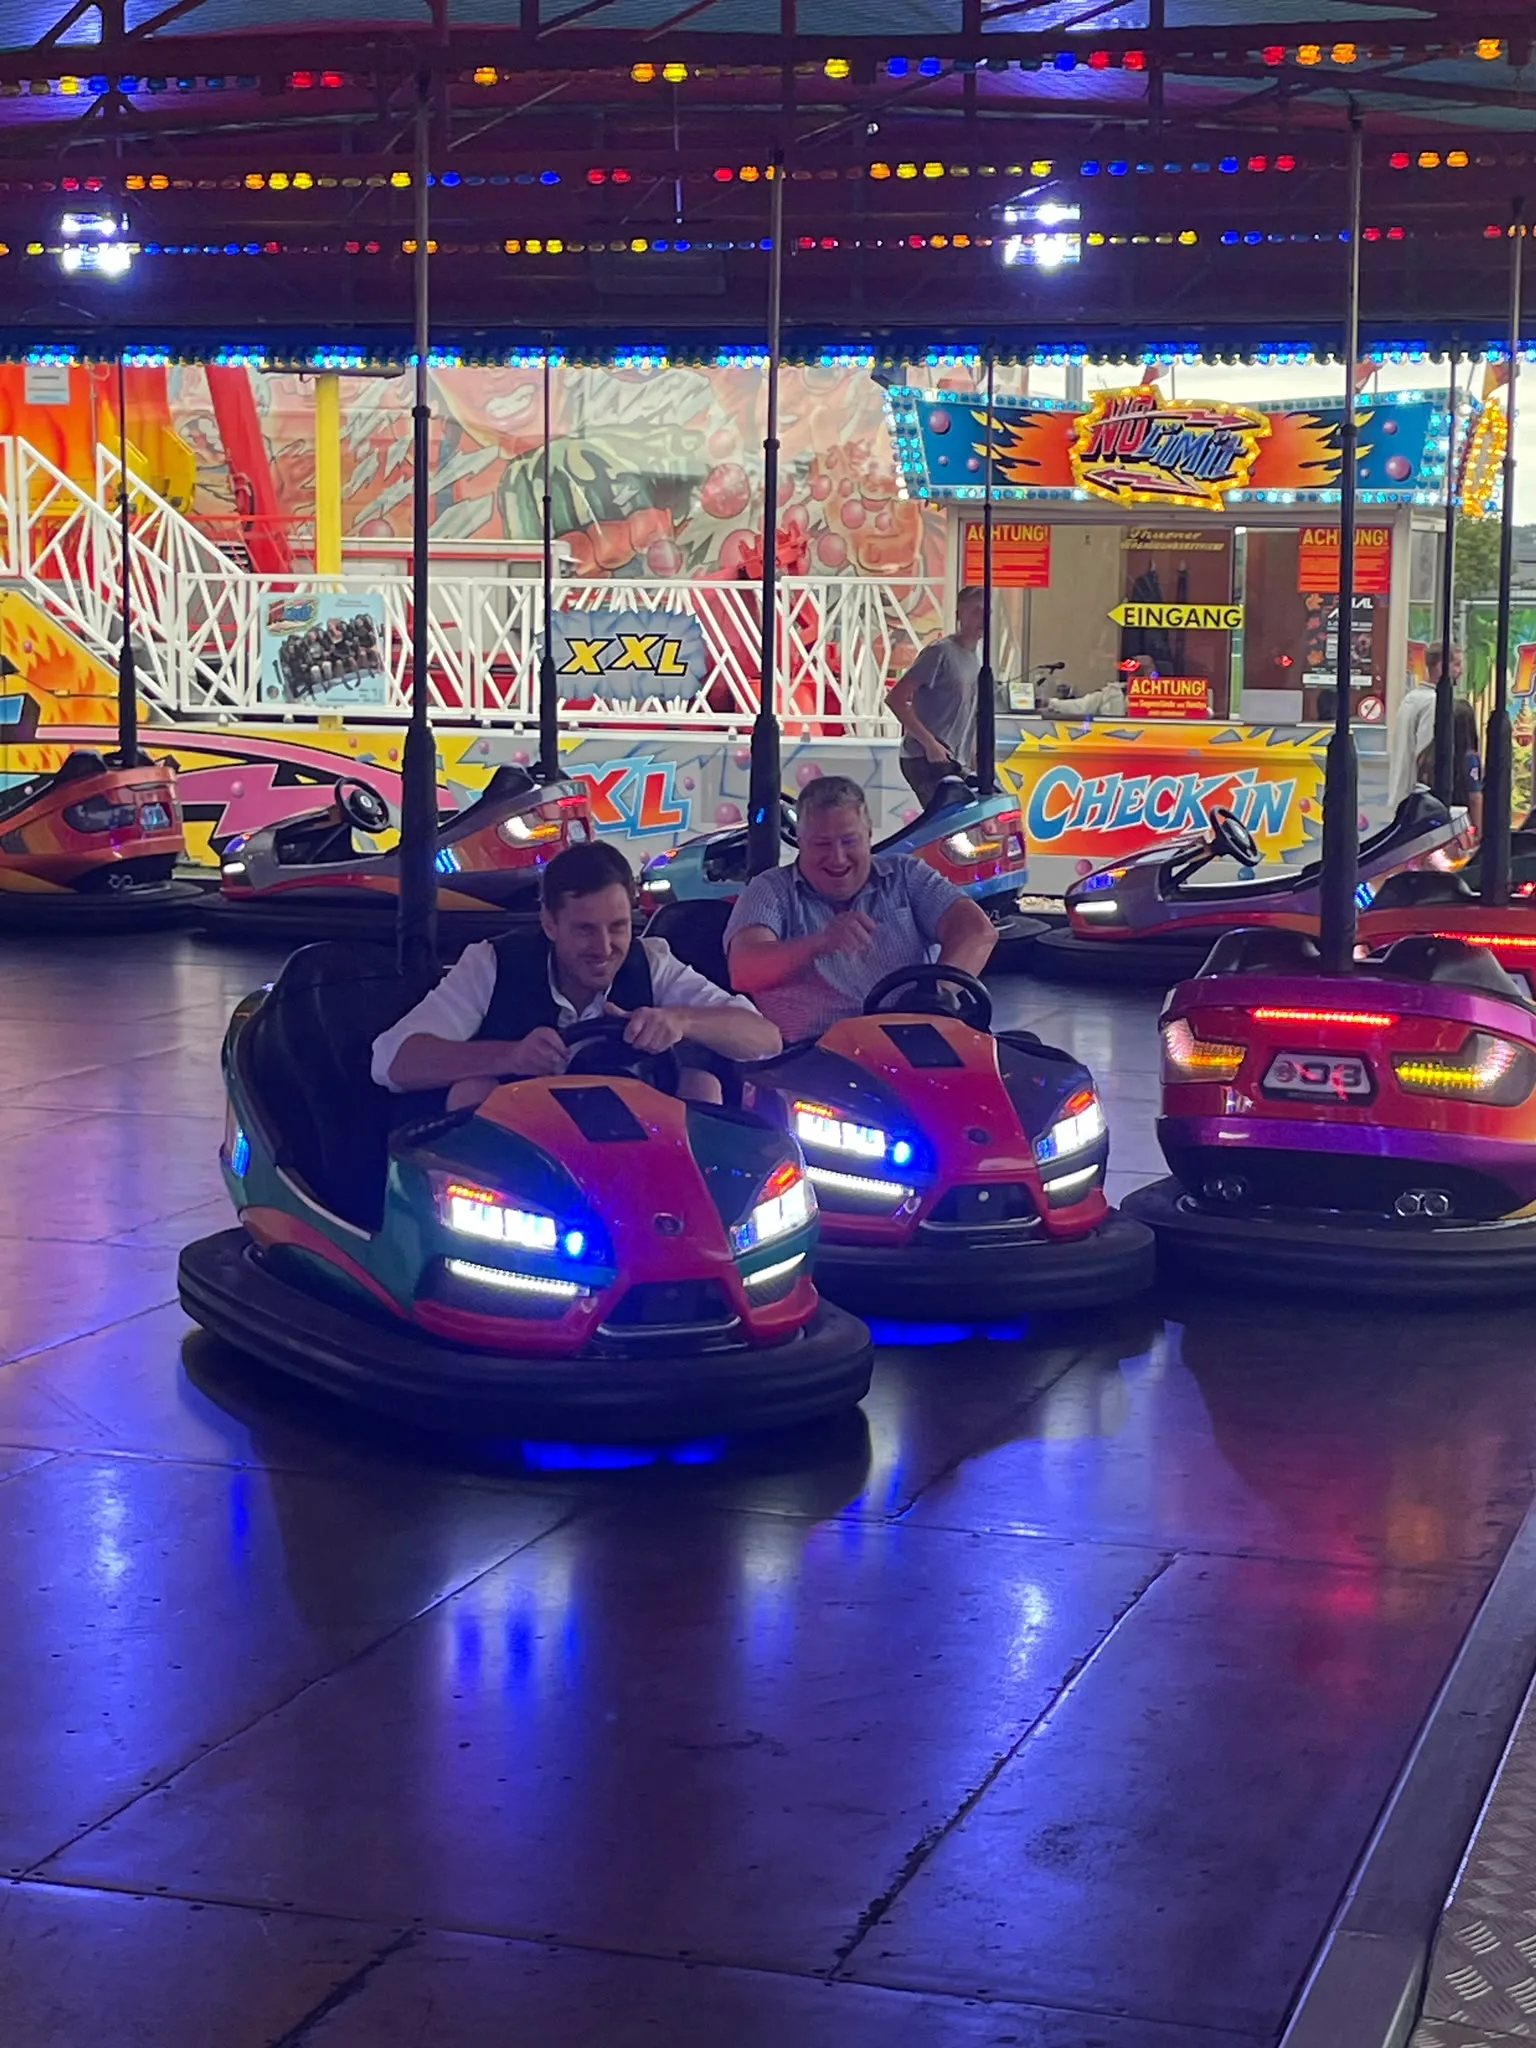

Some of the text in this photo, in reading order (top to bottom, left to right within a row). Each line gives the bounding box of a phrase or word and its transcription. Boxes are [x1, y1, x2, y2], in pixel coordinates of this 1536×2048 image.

[1082, 396, 1156, 456] NO
[1123, 607, 1242, 627] EINGANG
[557, 633, 688, 676] XXL
[1130, 679, 1206, 696] ACHTUNG!
[1027, 764, 1236, 842] CHECK
